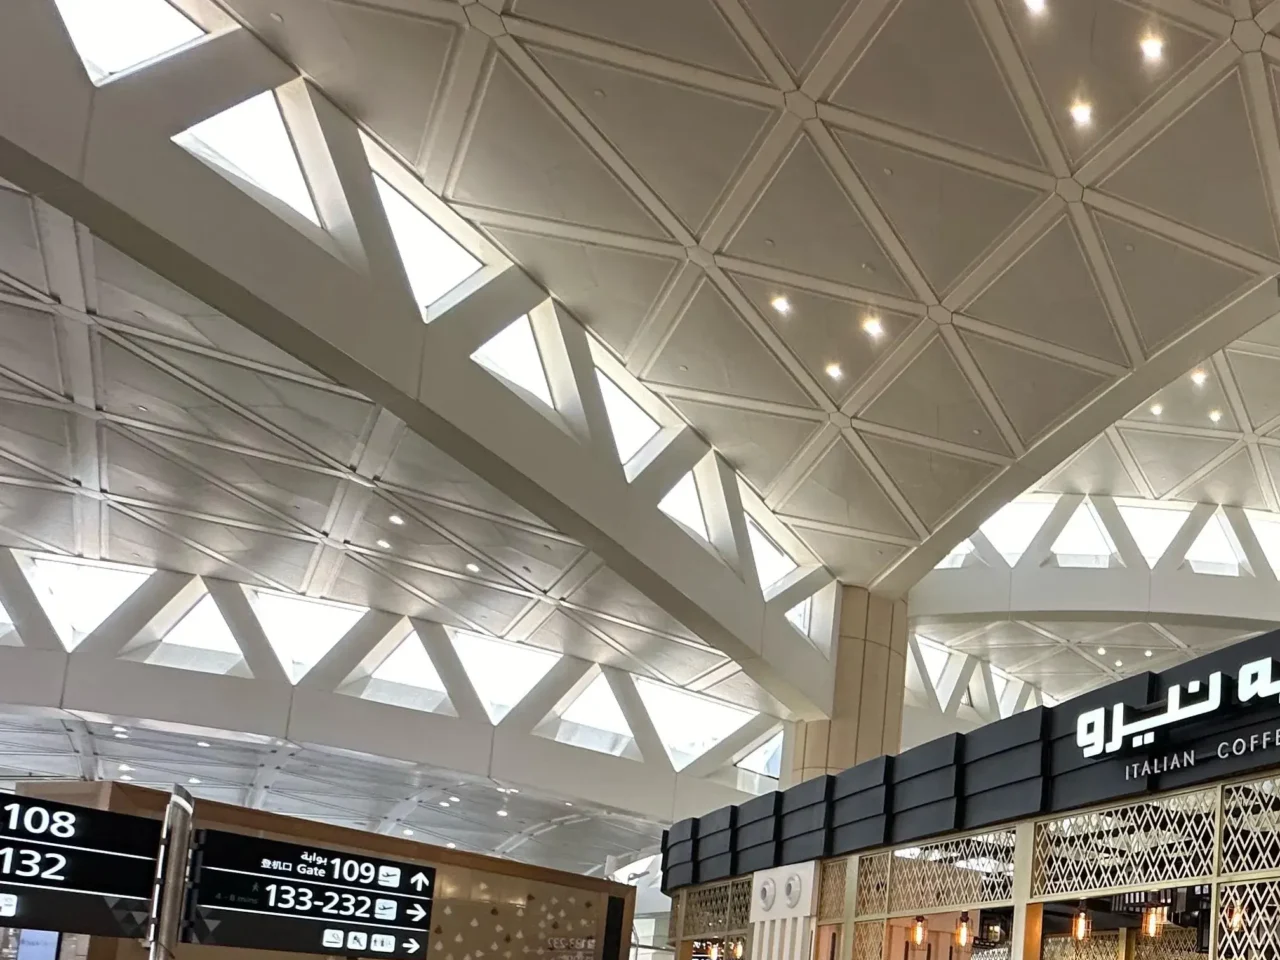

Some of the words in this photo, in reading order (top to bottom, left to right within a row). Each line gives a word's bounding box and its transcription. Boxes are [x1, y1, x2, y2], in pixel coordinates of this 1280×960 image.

[1076, 671, 1222, 759] نيرو
[1125, 750, 1196, 780] ITALIAN
[4, 803, 76, 838] 108
[0, 846, 67, 881] 132
[260, 858, 293, 872] 登机口
[296, 863, 327, 878] Gate
[330, 857, 376, 885] 109
[300, 851, 328, 866] بوابة
[265, 883, 372, 918] 133-232
